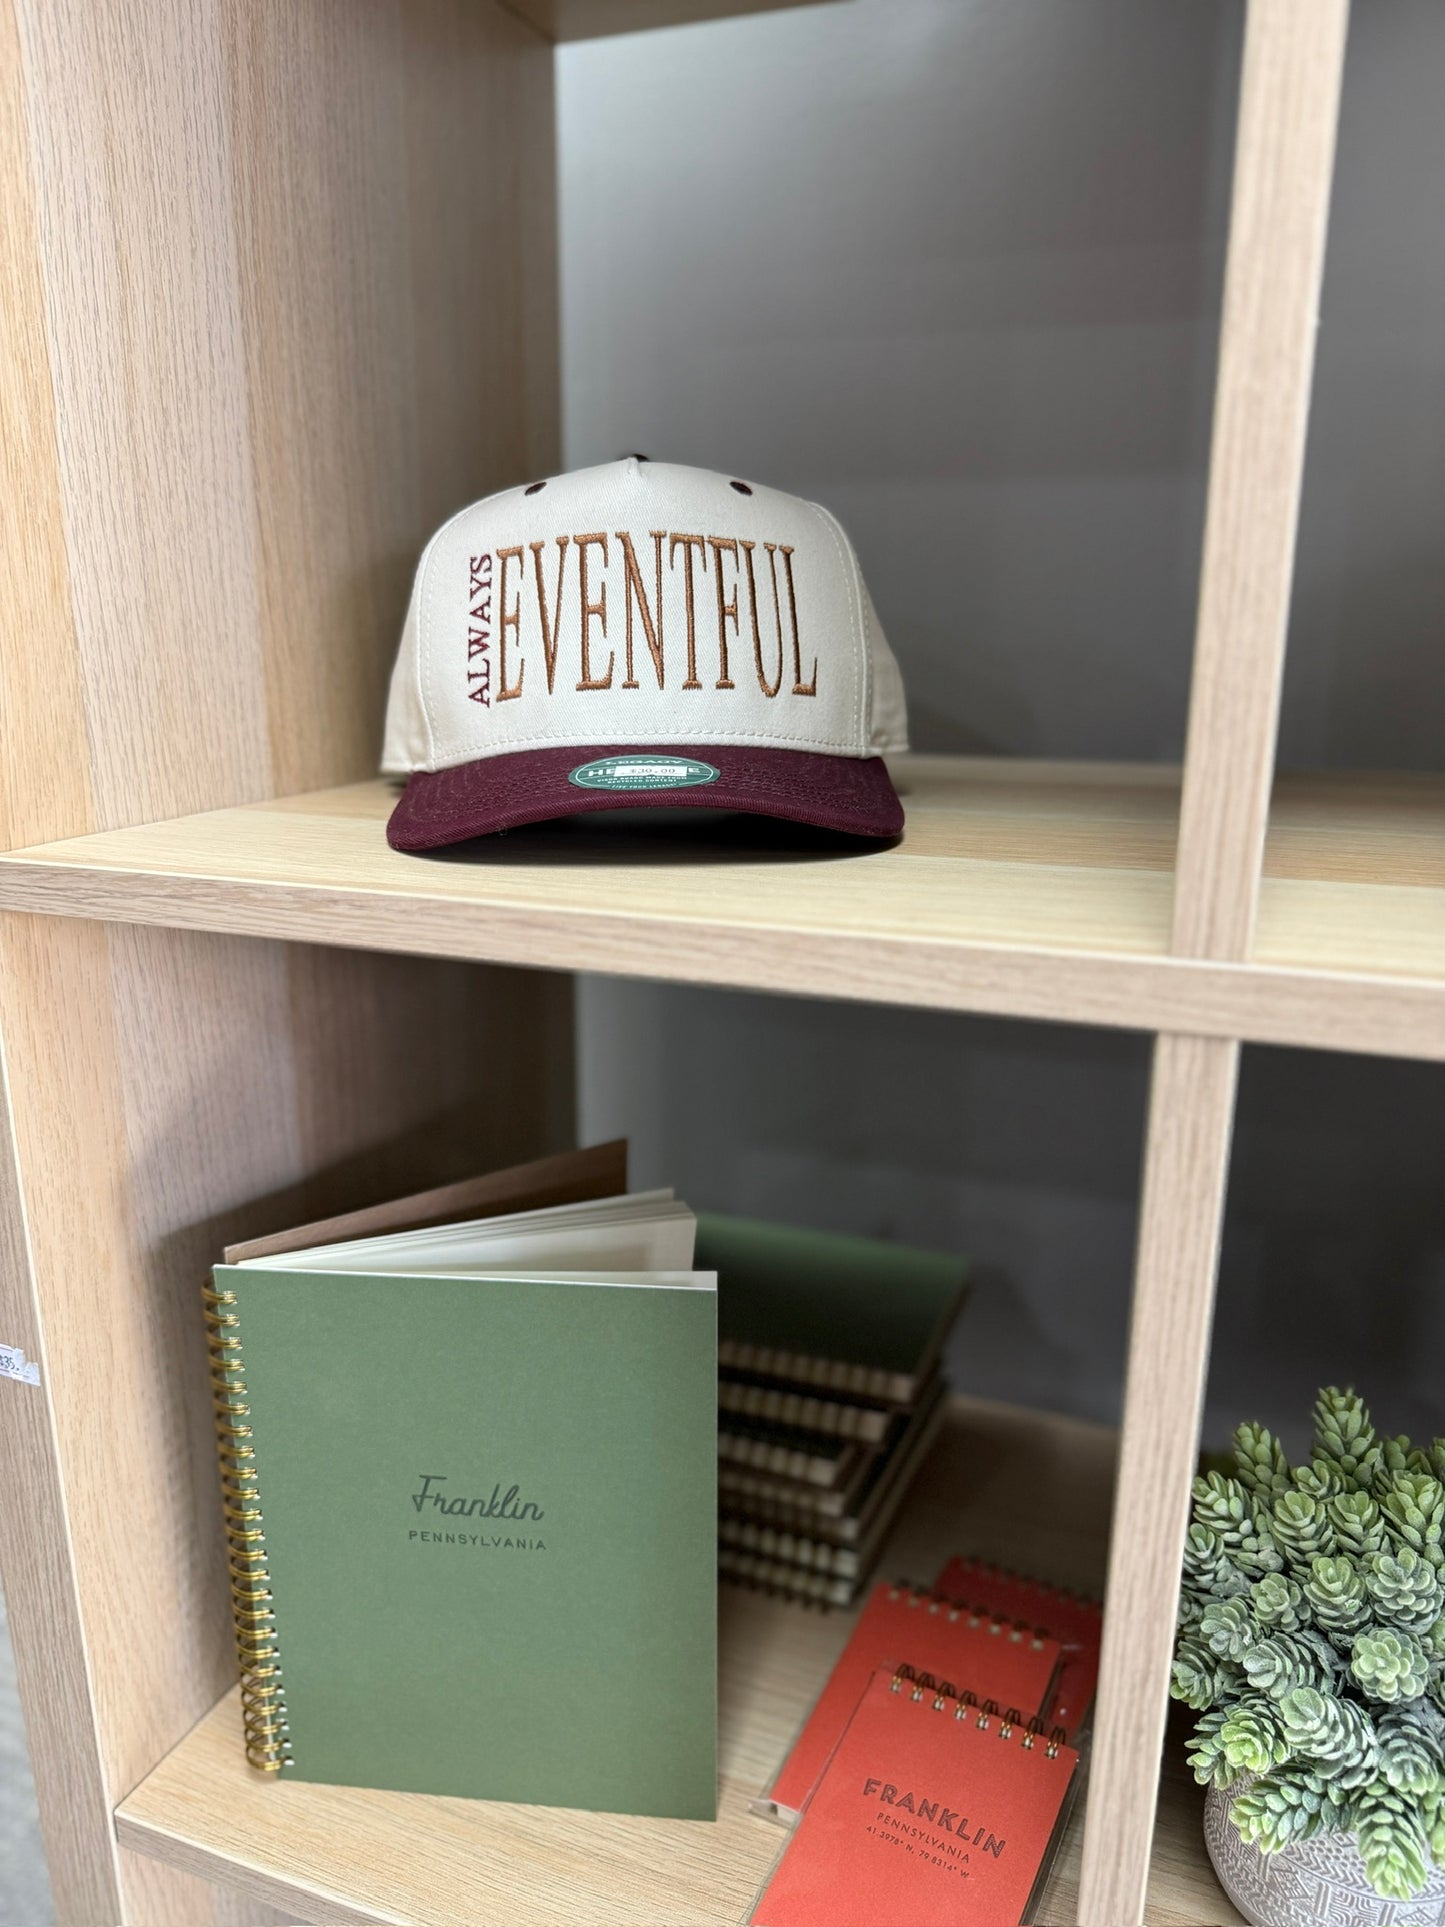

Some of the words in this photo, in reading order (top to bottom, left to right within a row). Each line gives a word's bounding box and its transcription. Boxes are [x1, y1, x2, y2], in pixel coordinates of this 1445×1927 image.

[468, 553, 492, 708] ALWAYS
[496, 531, 817, 702] EVENTFUL
[412, 1475, 545, 1521] Franklin
[408, 1530, 547, 1550] PENNSYLVANIA
[863, 1778, 1006, 1859] FRANKLIN
[877, 1812, 970, 1864] PENNSYLVANIA
[960, 1870, 969, 1879] W
